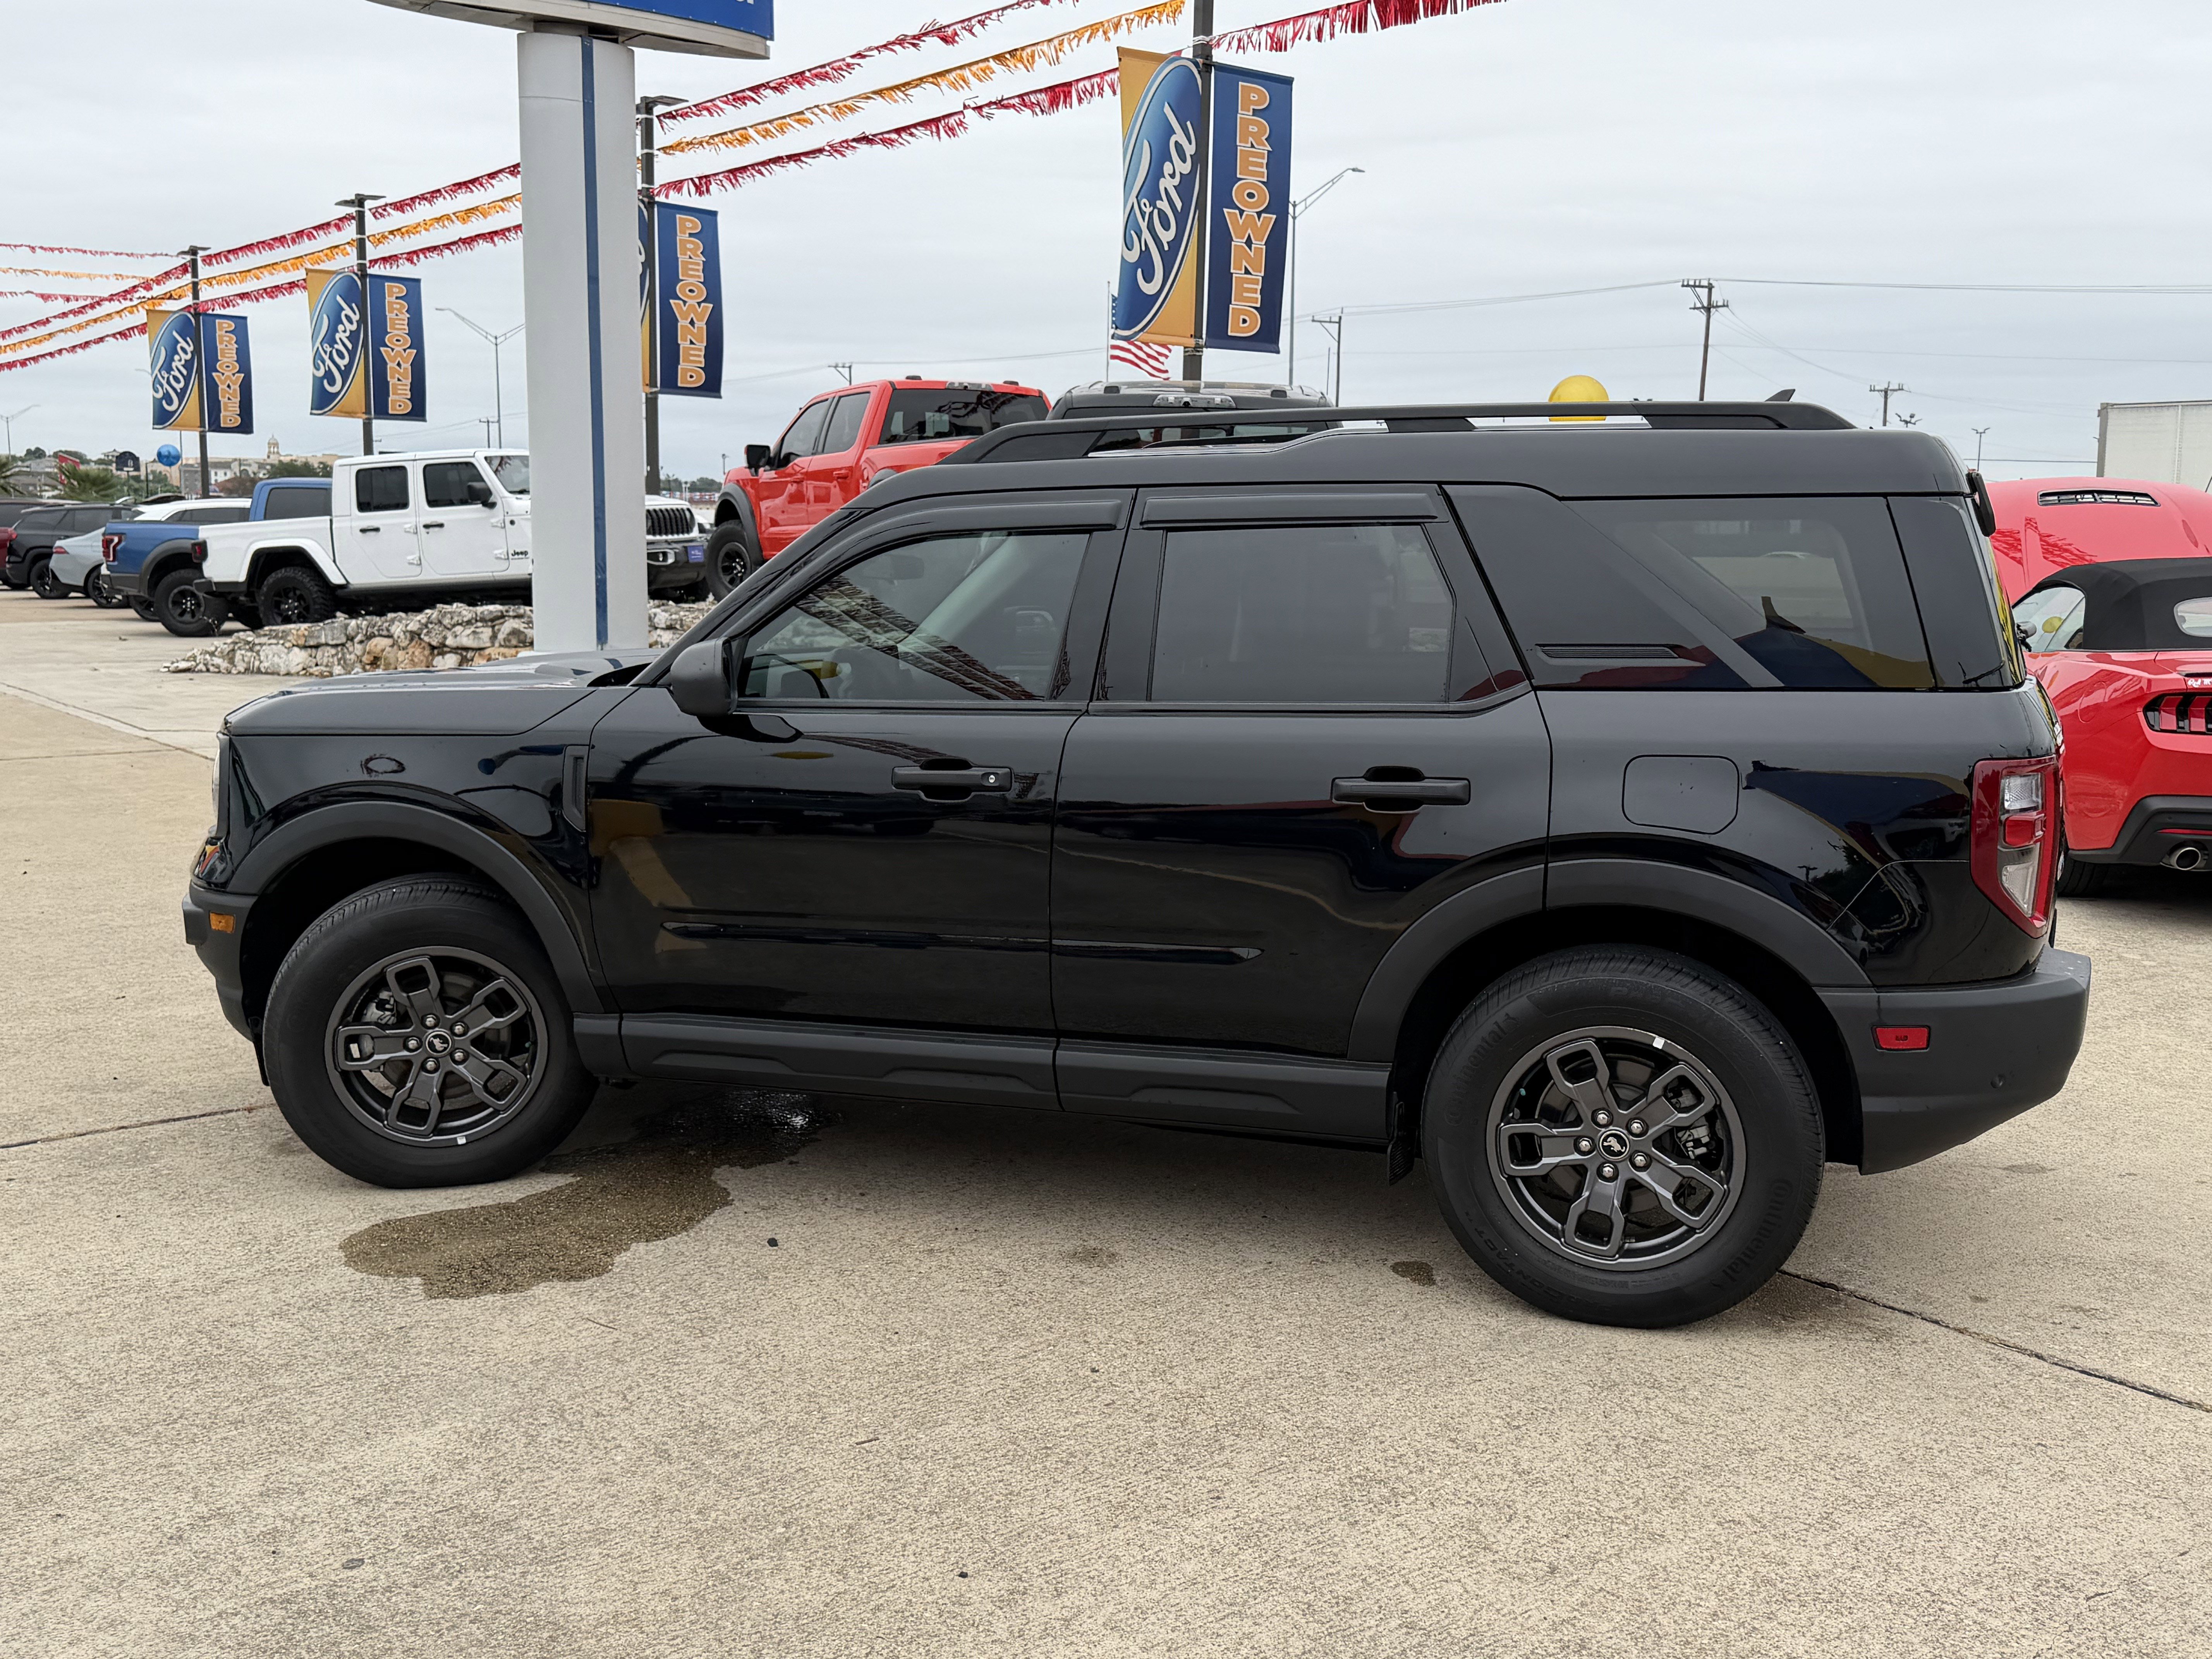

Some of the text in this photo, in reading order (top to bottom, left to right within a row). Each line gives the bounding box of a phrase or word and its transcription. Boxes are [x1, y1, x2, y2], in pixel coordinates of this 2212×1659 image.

[1122, 101, 1196, 295] Ford
[1223, 81, 1276, 337] PREOWNED
[313, 294, 360, 393] Ford
[380, 282, 417, 414] PREOWNED
[670, 214, 713, 388] PREOWNED
[152, 330, 194, 412] Ford
[212, 319, 245, 428] PREOWNED
[1721, 1178, 1794, 1283] Continental
